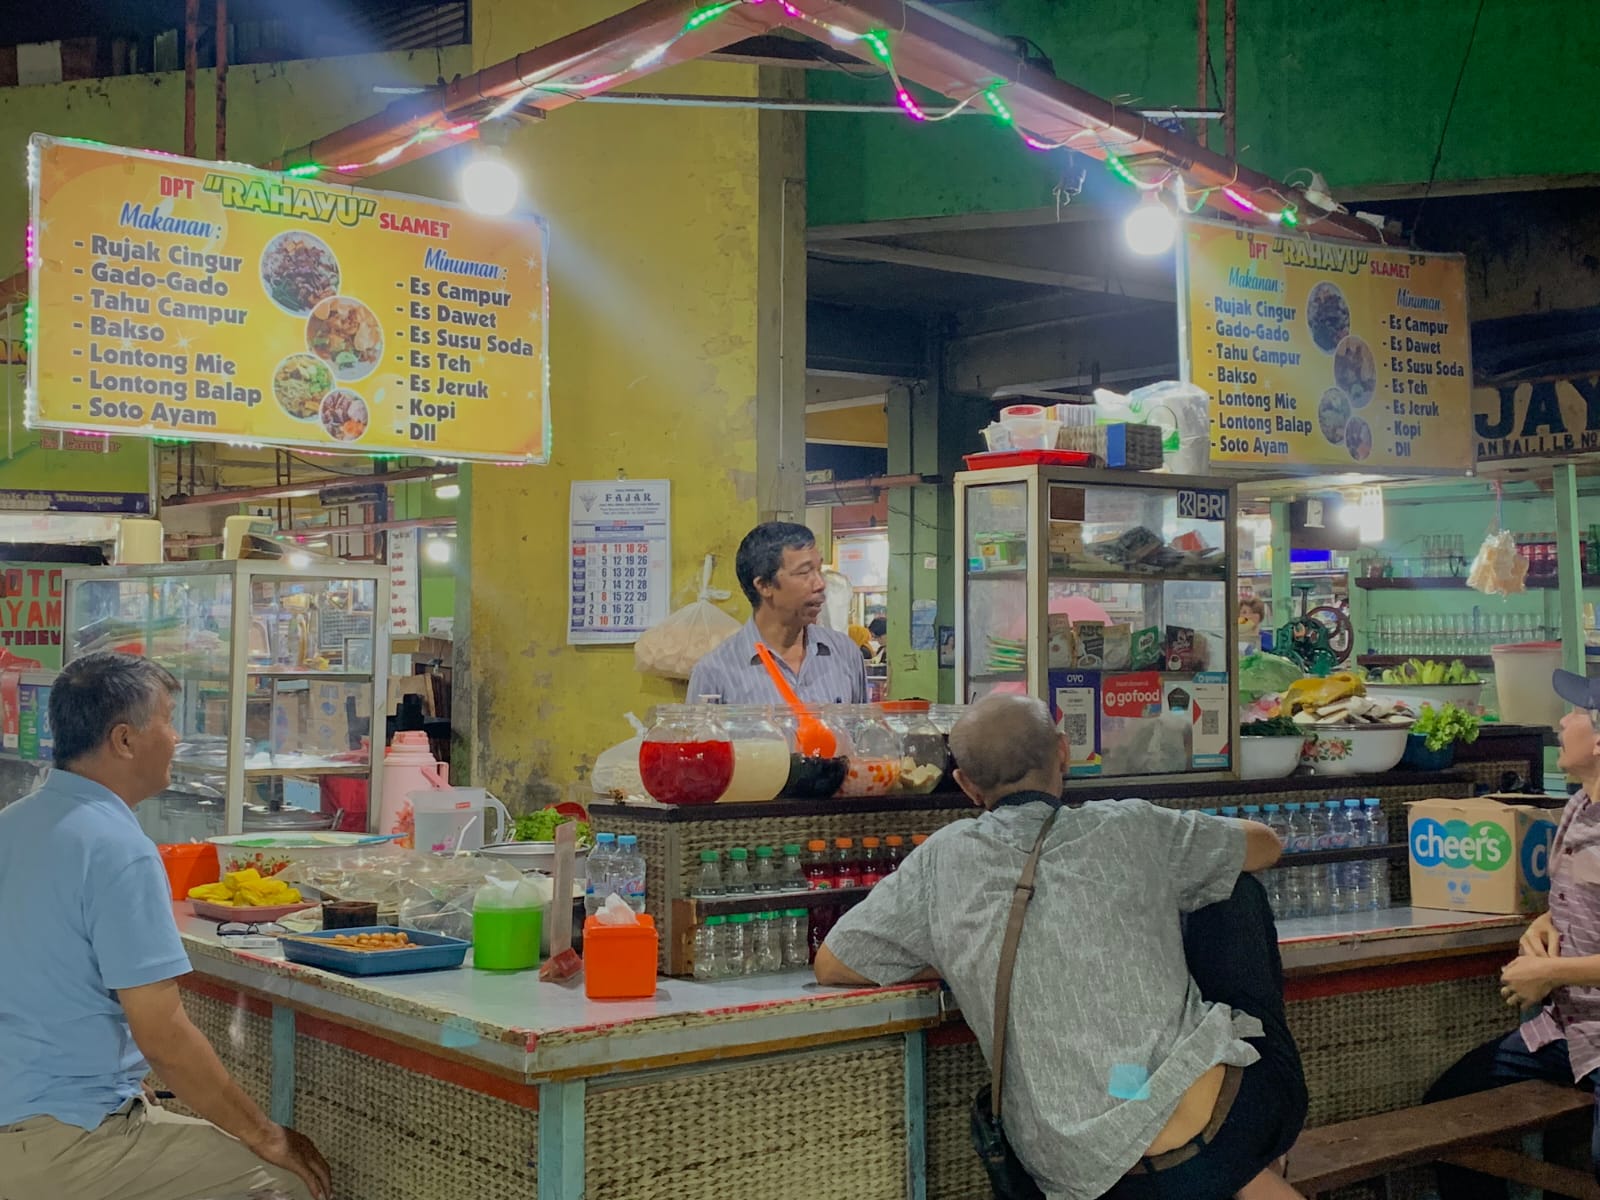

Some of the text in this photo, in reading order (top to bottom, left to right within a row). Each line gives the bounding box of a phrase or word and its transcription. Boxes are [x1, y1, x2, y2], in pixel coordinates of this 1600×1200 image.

[160, 174, 450, 238] DPT "RAHAYU" SLAMET
[92, 235, 242, 273] Rujak Cingur
[1249, 241, 1268, 260] DPT
[1370, 260, 1410, 278] SLAMET
[91, 262, 228, 296] Gado-Gado
[410, 277, 511, 307] Es Campur
[90, 289, 248, 325] Tahu Campur
[410, 302, 496, 328] Es Dawet
[1215, 296, 1296, 322] Rujak Cingur
[90, 316, 165, 342] Bakso
[1216, 320, 1289, 341] Gado-Gado
[1390, 314, 1448, 336] Es Campur
[410, 326, 533, 356] Es Susu Soda
[1391, 336, 1440, 354] Es Dawet
[90, 343, 236, 375] Lontong Mie
[410, 350, 470, 372] Es Teh
[1216, 343, 1301, 367] Tahu Campur
[1217, 366, 1257, 384] Bakso
[1392, 357, 1464, 376] Es Susu Soda
[90, 370, 262, 407] Lontong Balap
[410, 374, 488, 398] Es Jeruk
[1392, 378, 1427, 395] Es Teh
[410, 399, 455, 421] Kopi
[1218, 389, 1296, 411] Lontong Mie
[1394, 399, 1439, 416] Es Jeruk
[90, 397, 216, 426] Soto Ayam
[1220, 412, 1312, 436] Lontong Balap
[1395, 421, 1420, 439] Kopi
[1220, 436, 1288, 456] Soto Ayam
[1196, 494, 1226, 518] BRI
[602, 544, 607, 553] 4
[614, 544, 622, 553] 11
[637, 544, 648, 553] 25
[602, 556, 648, 565] 5 12 19 26
[602, 568, 647, 577] 6 13 20 27
[602, 580, 648, 590] 7 14 21 28
[601, 592, 607, 601] 8
[613, 592, 622, 601] 15
[624, 592, 634, 601] 22
[637, 592, 647, 601] 29
[589, 604, 634, 614] 2 9 16 23
[588, 616, 594, 625] 3
[613, 616, 621, 625] 17
[624, 616, 634, 625] 24
[1117, 689, 1160, 706] gofood
[1415, 824, 1500, 862] cheers
